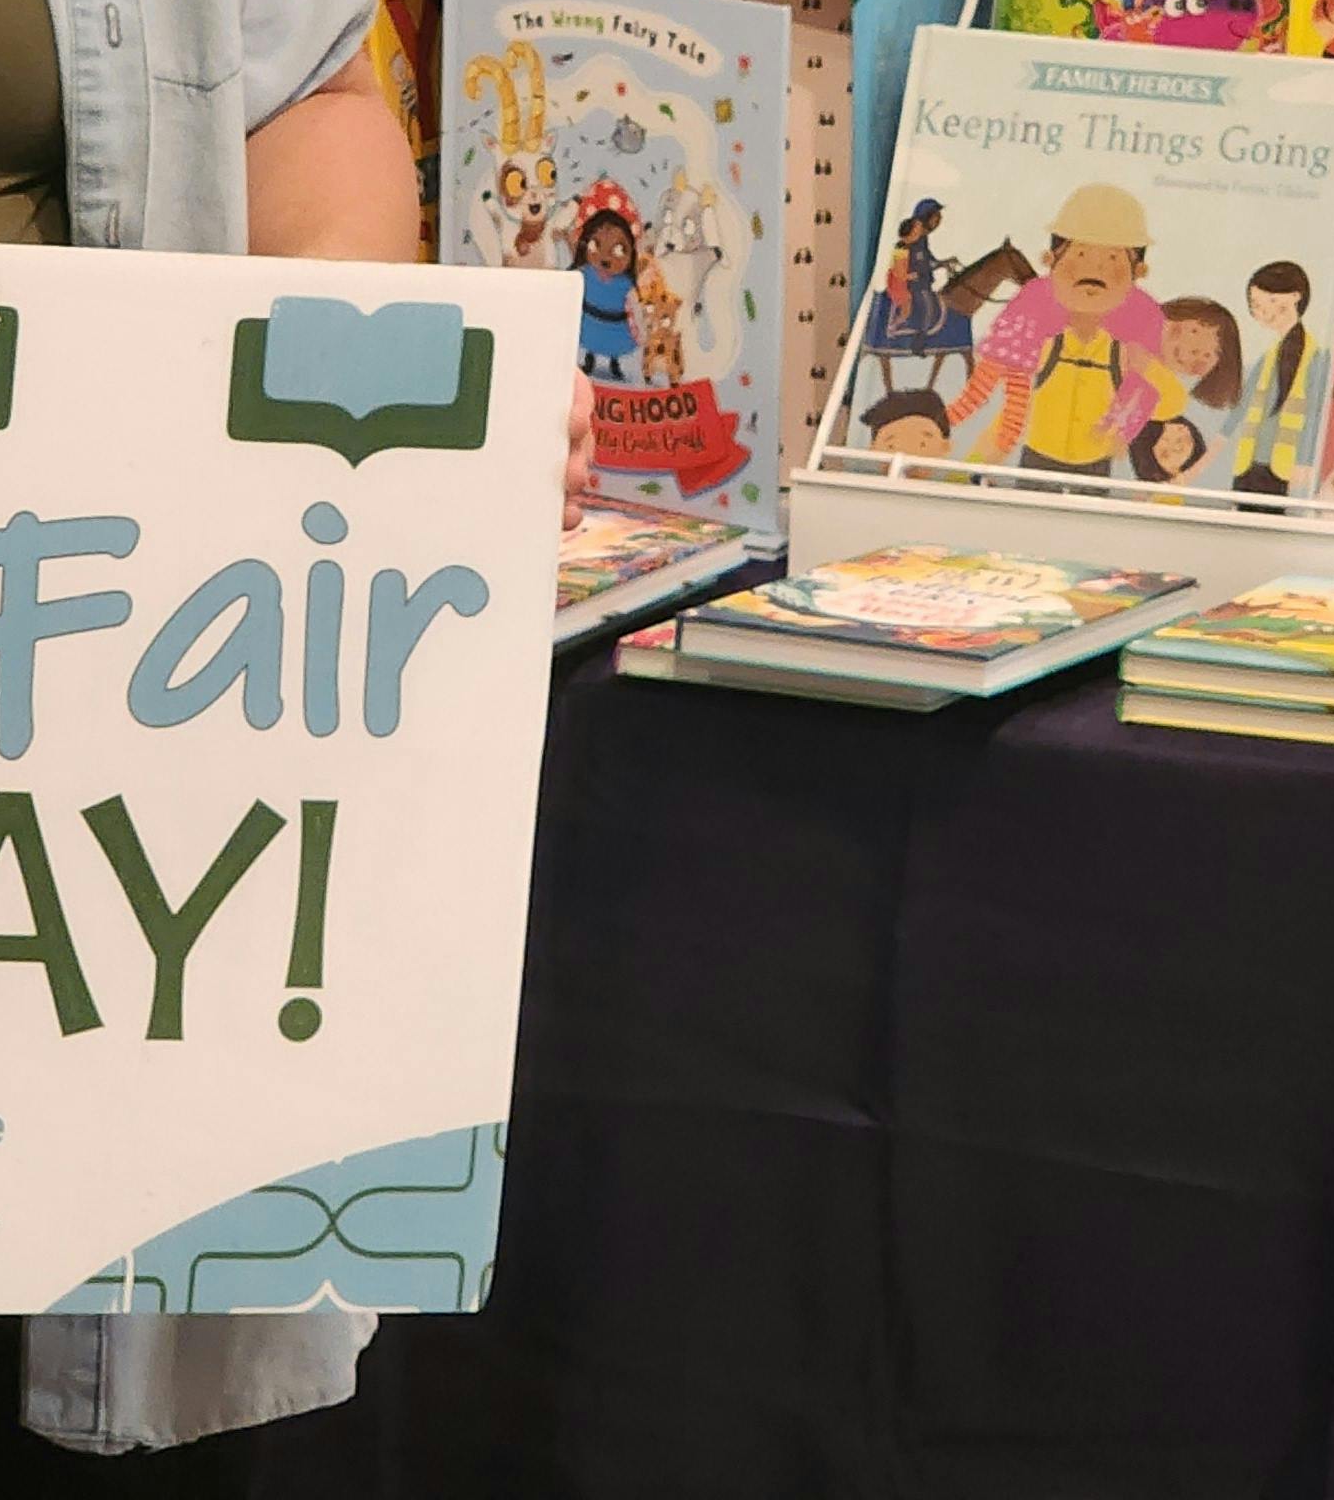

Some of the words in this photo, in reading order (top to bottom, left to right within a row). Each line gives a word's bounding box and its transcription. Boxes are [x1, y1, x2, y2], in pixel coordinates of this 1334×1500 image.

[513, 11, 544, 31] The
[551, 9, 605, 35] Wrong
[612, 14, 658, 47] Fairy
[667, 30, 706, 64] Tale
[1046, 66, 1125, 92] FAMILY
[1128, 74, 1213, 100] HEROES
[915, 98, 1065, 155] Keeping
[1080, 113, 1204, 164] Things
[1218, 124, 1332, 177] Going
[630, 391, 698, 424] HOOD
